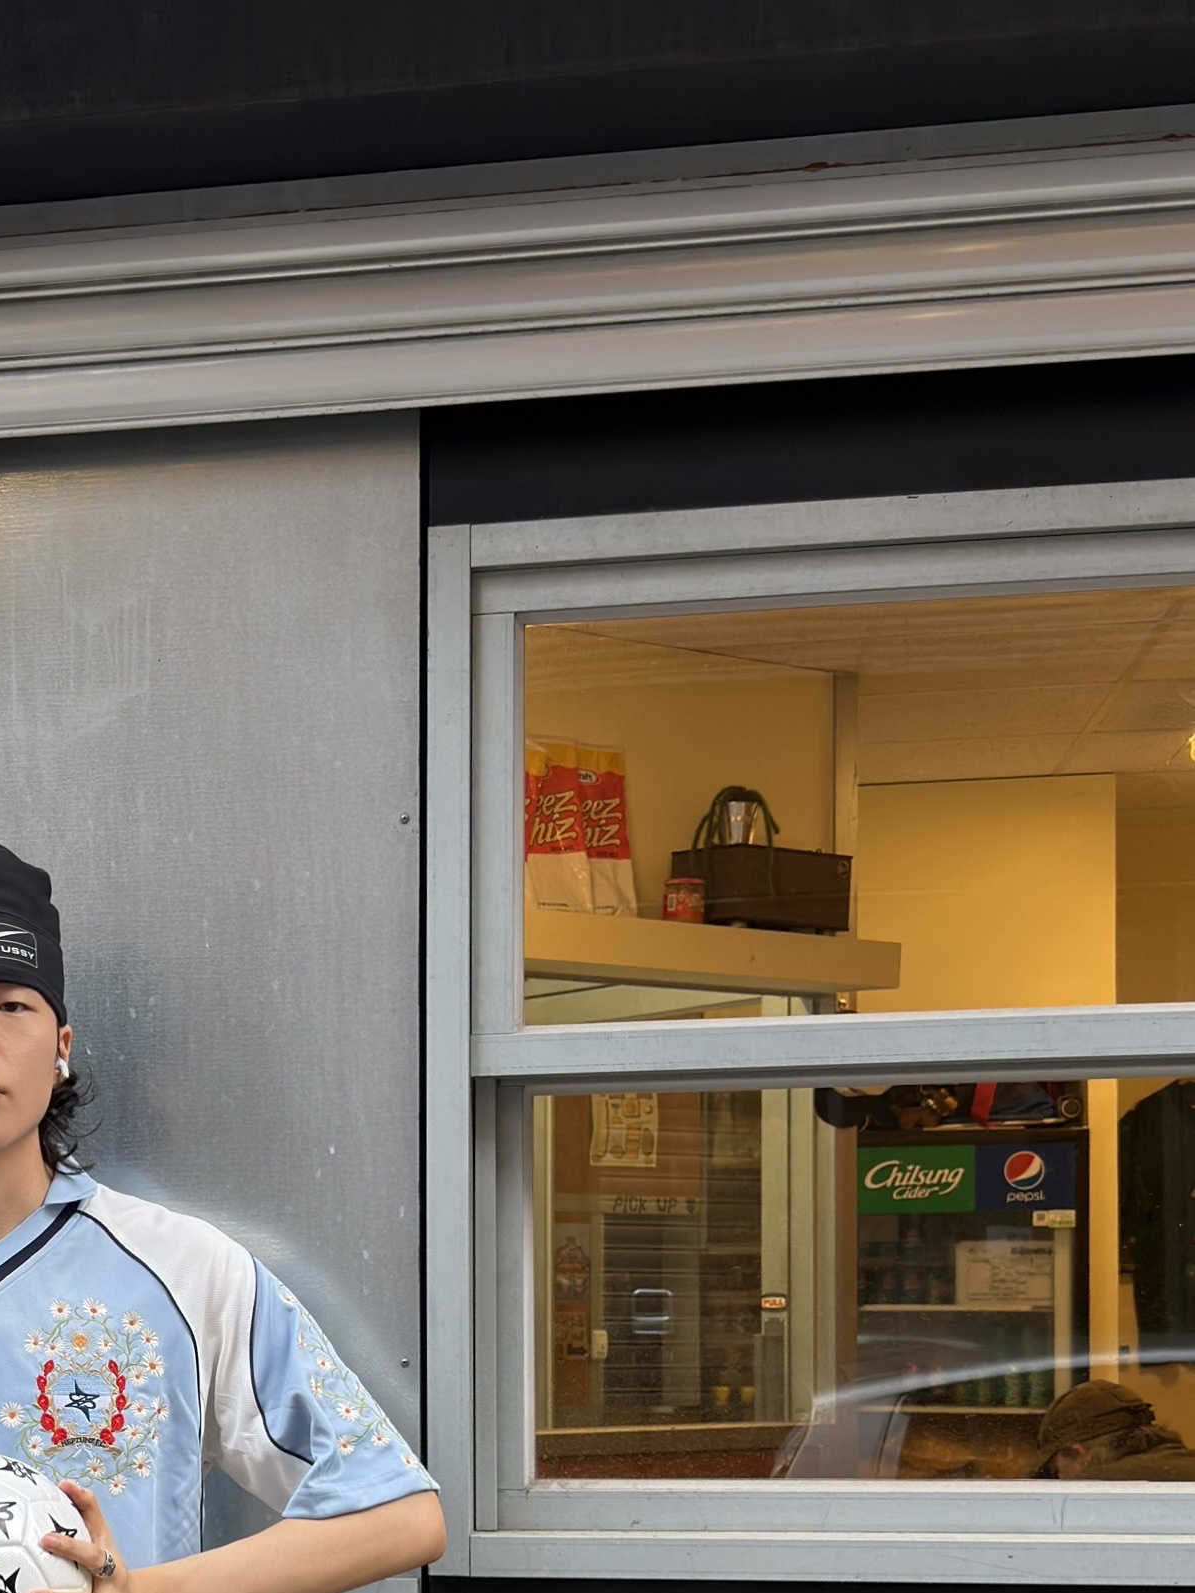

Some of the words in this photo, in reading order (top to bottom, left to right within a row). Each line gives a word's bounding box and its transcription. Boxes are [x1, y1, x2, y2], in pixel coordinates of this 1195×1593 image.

[864, 1160, 964, 1195] Chilsung
[892, 1186, 940, 1200] Cider
[1006, 1190, 1045, 1203] pepsi
[612, 1195, 647, 1215] PICK
[656, 1196, 678, 1214] UP
